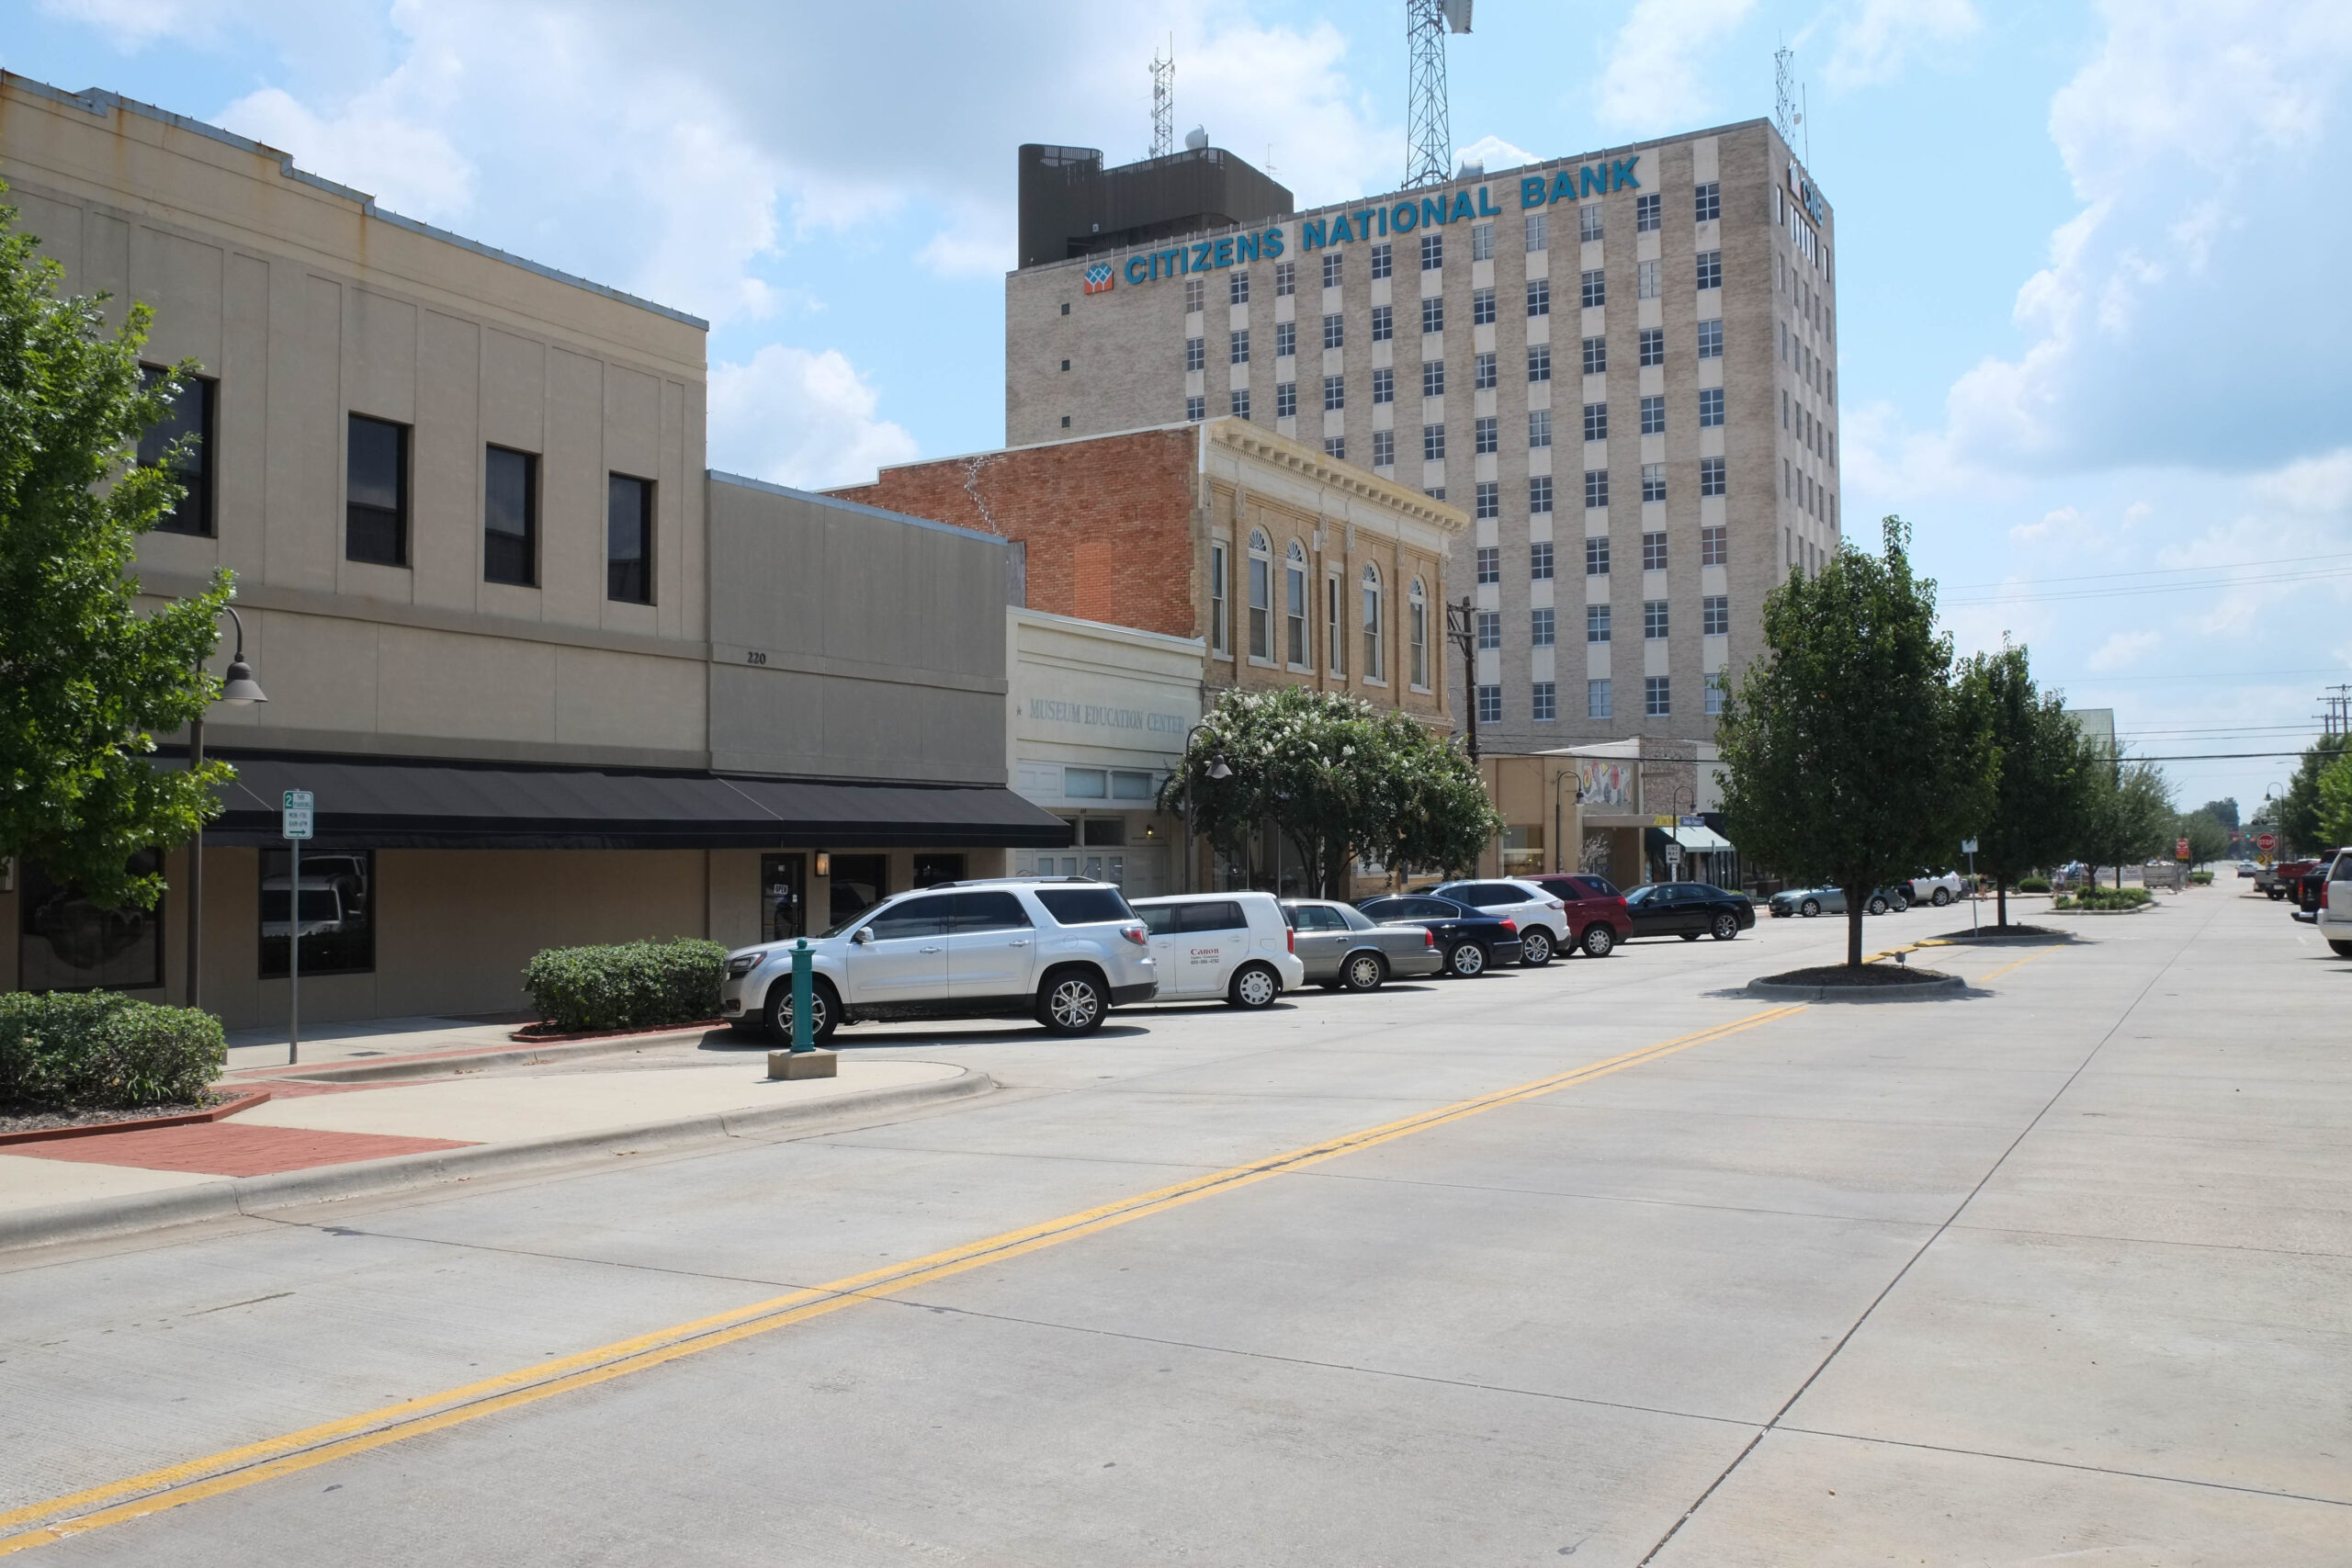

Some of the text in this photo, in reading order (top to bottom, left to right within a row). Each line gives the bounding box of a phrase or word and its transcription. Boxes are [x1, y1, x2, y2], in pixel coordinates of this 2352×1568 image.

[1125, 156, 1641, 285] CITIZENS NATIONAL BANK
[747, 650, 766, 665] 220
[1029, 698, 1186, 735] MUSEUM EDUCATION CENTER
[286, 795, 292, 807] 2
[2258, 838, 2275, 846] STOP
[775, 885, 787, 894] OPEN
[1190, 947, 1220, 956] Canon
